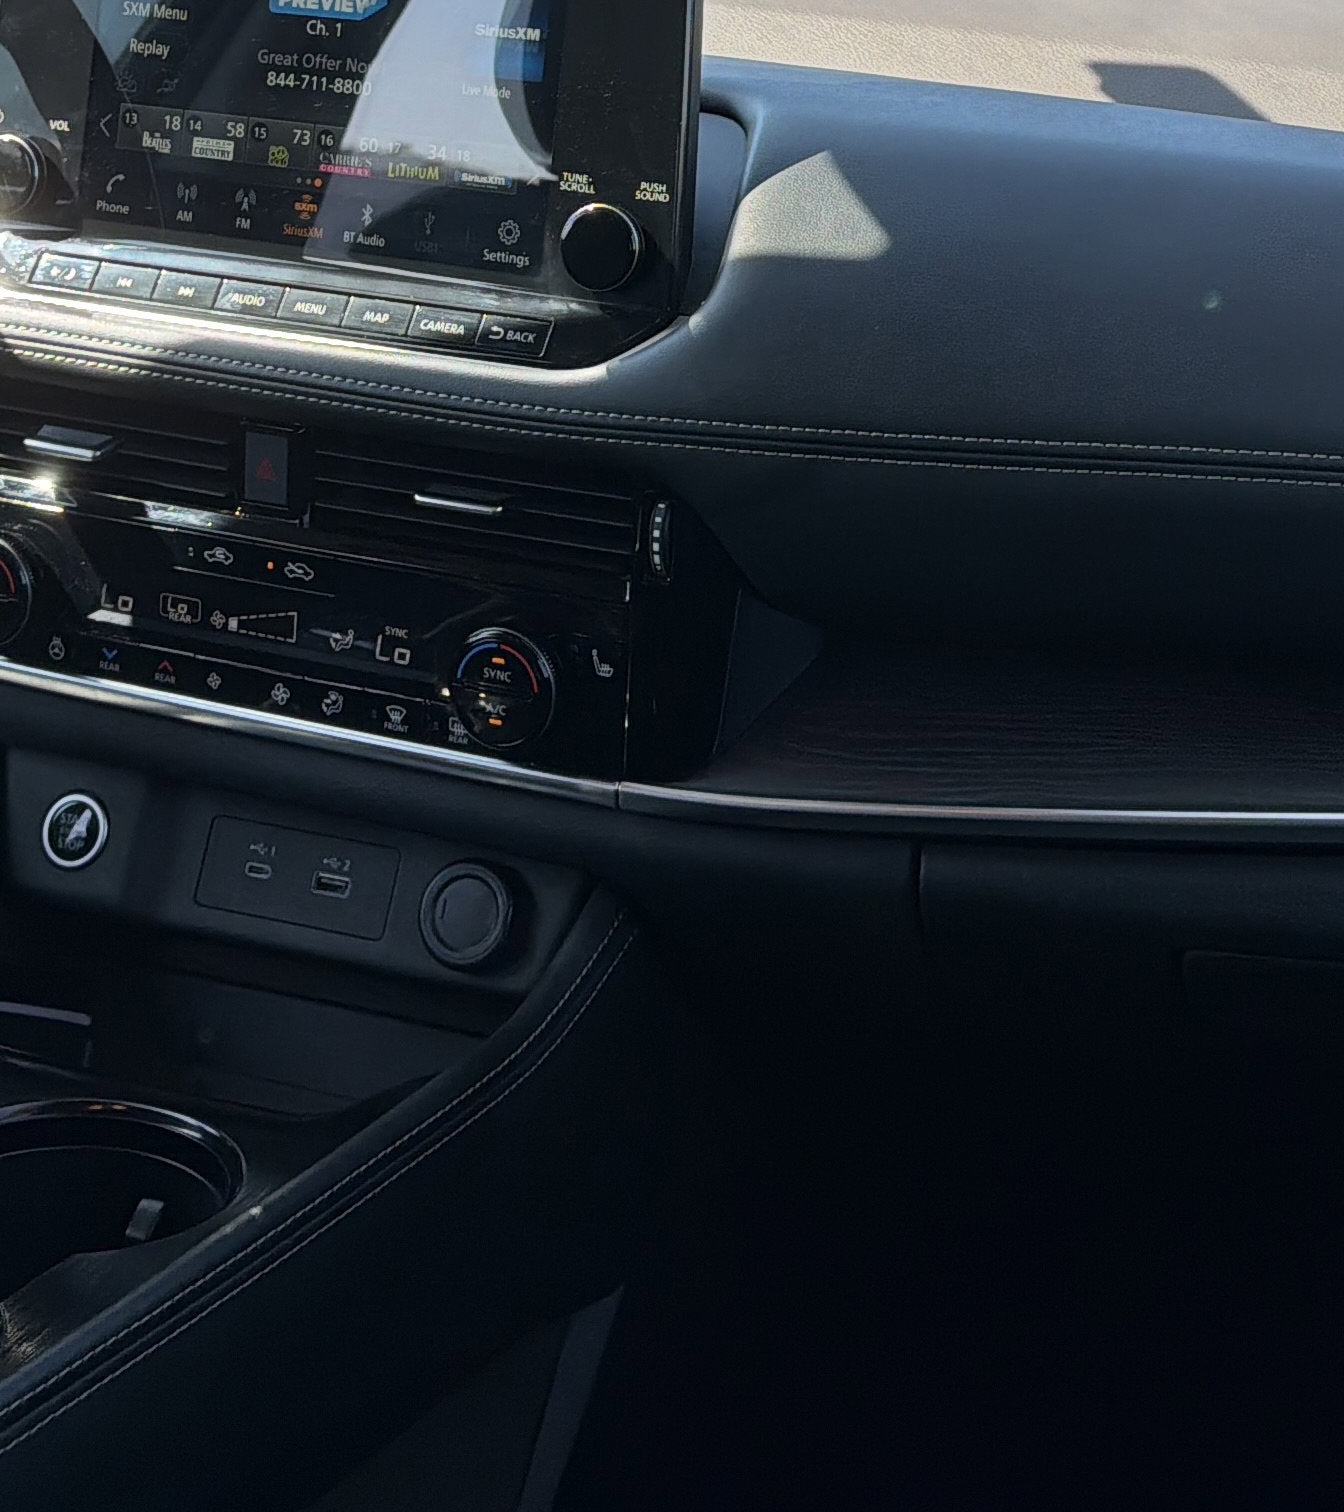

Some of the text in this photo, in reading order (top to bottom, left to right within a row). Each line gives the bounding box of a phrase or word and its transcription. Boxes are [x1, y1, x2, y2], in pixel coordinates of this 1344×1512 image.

[122, 0, 189, 21] SXM Menu
[306, 19, 343, 38] Ch. 1
[474, 23, 541, 42] SiriusXM
[129, 37, 171, 60] Replay
[257, 48, 373, 74] Great Offer No
[266, 70, 373, 96] 844-711-8800
[461, 83, 481, 95] Live
[48, 119, 71, 132] VOL
[124, 112, 139, 125] 13
[163, 114, 182, 132] 18
[188, 119, 203, 133] 14
[226, 121, 246, 138] 58
[253, 127, 268, 140] 15
[292, 128, 312, 147] 73
[319, 133, 335, 147] 16
[359, 137, 379, 153] 60
[194, 145, 232, 159] COUNTRY
[427, 143, 448, 161] 34
[319, 164, 371, 177] COUNTRY
[559, 181, 596, 194] SCROLL
[639, 181, 667, 193] PUSH
[635, 190, 670, 203] SOUND
[96, 199, 130, 215] Phone
[176, 210, 193, 223] AM
[235, 217, 251, 230] FM
[343, 230, 386, 248] BT Audio
[482, 248, 531, 269] Settings
[230, 292, 265, 308] AUDIO
[293, 300, 328, 316] MENU
[362, 309, 390, 324] MAP
[419, 318, 465, 336] CAMERA
[505, 329, 537, 344] BACK
[100, 582, 134, 612] Lo
[166, 595, 188, 615] Lo
[168, 611, 192, 624] REAR
[384, 624, 409, 639] SYNC
[375, 633, 411, 666] Lo
[99, 660, 121, 672] REAR
[154, 672, 177, 685] REAR
[482, 666, 512, 683] SYNC
[484, 701, 507, 717] A/C
[383, 720, 409, 733] FRONT
[448, 734, 469, 745] REAR
[342, 859, 352, 871] 2
